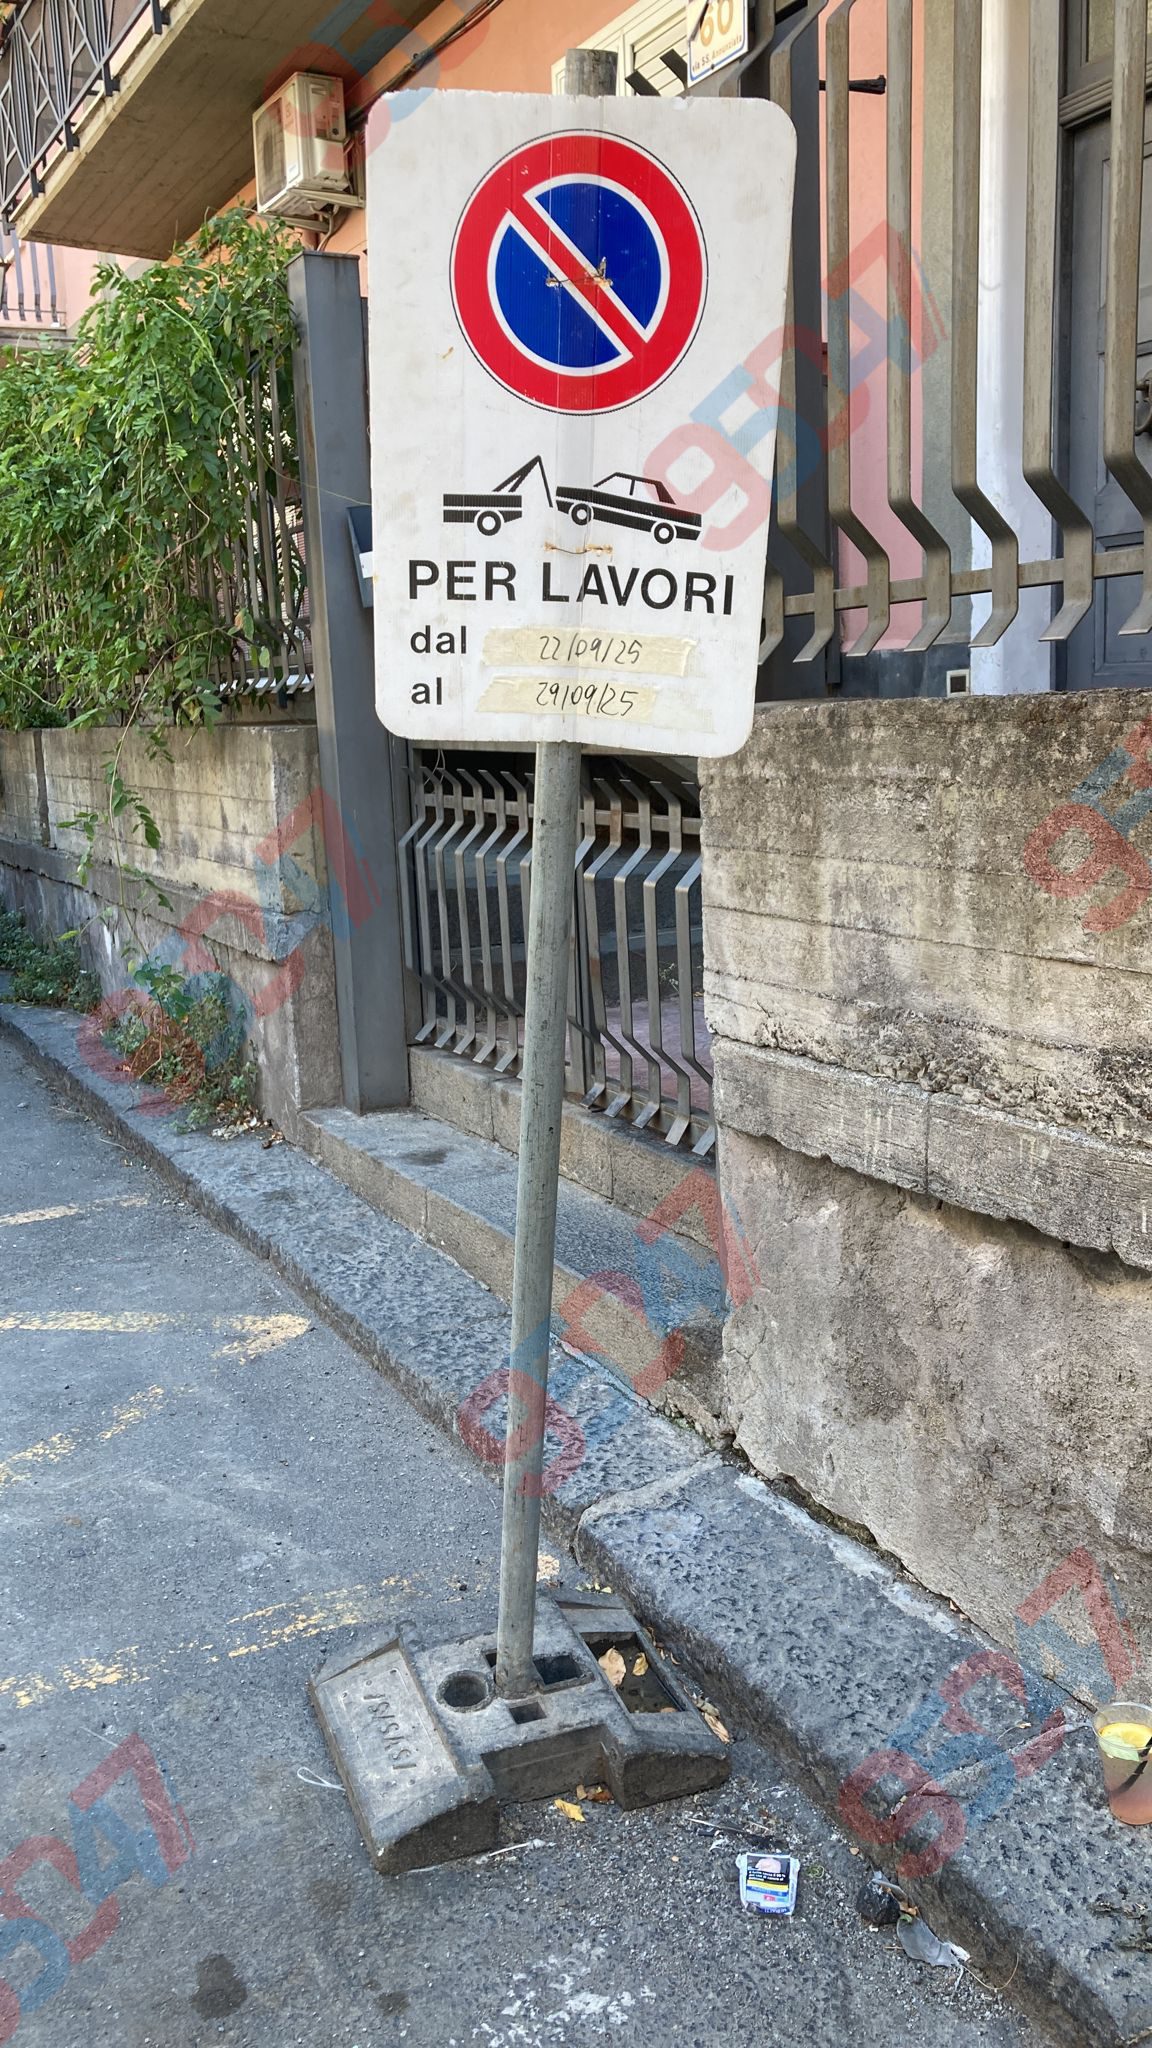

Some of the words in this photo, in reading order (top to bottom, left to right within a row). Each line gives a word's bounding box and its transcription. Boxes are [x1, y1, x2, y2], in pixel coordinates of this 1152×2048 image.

[409, 559, 516, 601] PER
[542, 562, 734, 615] LAVORI
[410, 625, 467, 654] dal
[539, 632, 643, 665] 22/09/25
[411, 677, 442, 705] al
[535, 682, 640, 717] 29/09/25
